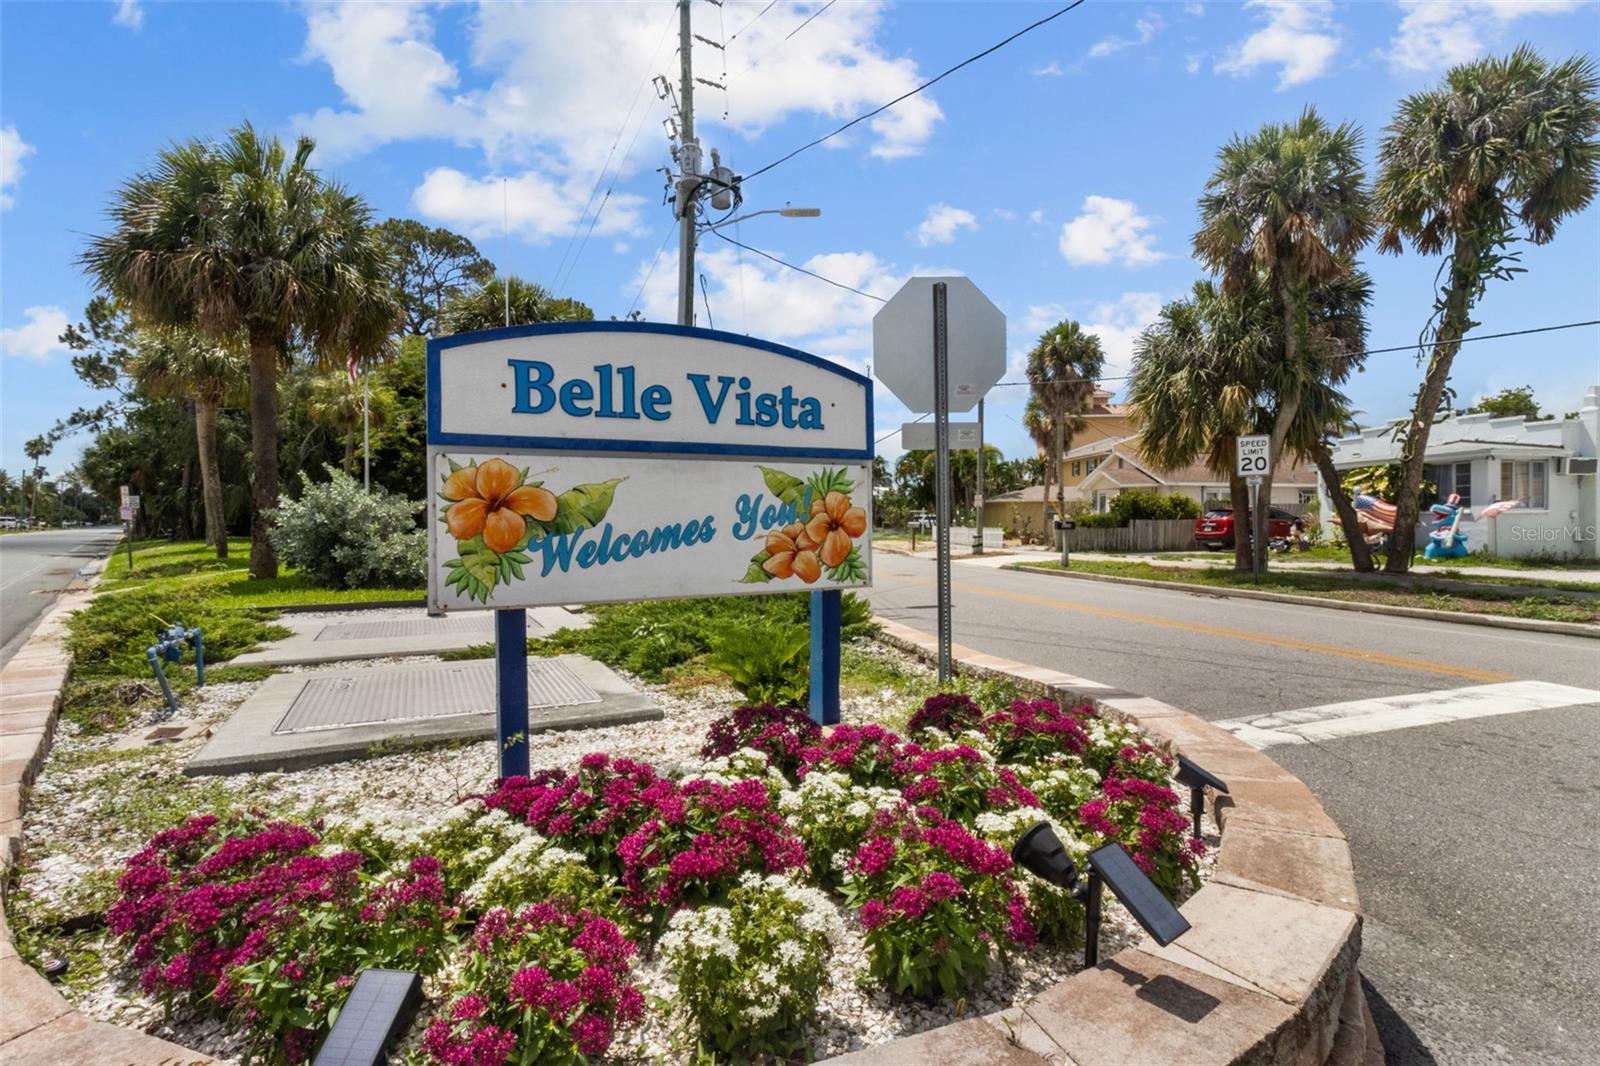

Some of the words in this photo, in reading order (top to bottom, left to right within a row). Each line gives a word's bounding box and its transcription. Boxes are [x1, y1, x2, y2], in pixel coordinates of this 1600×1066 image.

[508, 359, 672, 421] Belle
[687, 373, 825, 430] Vista
[1241, 457, 1267, 471] 20
[527, 514, 716, 577] Welcomes
[732, 486, 813, 540] You!
